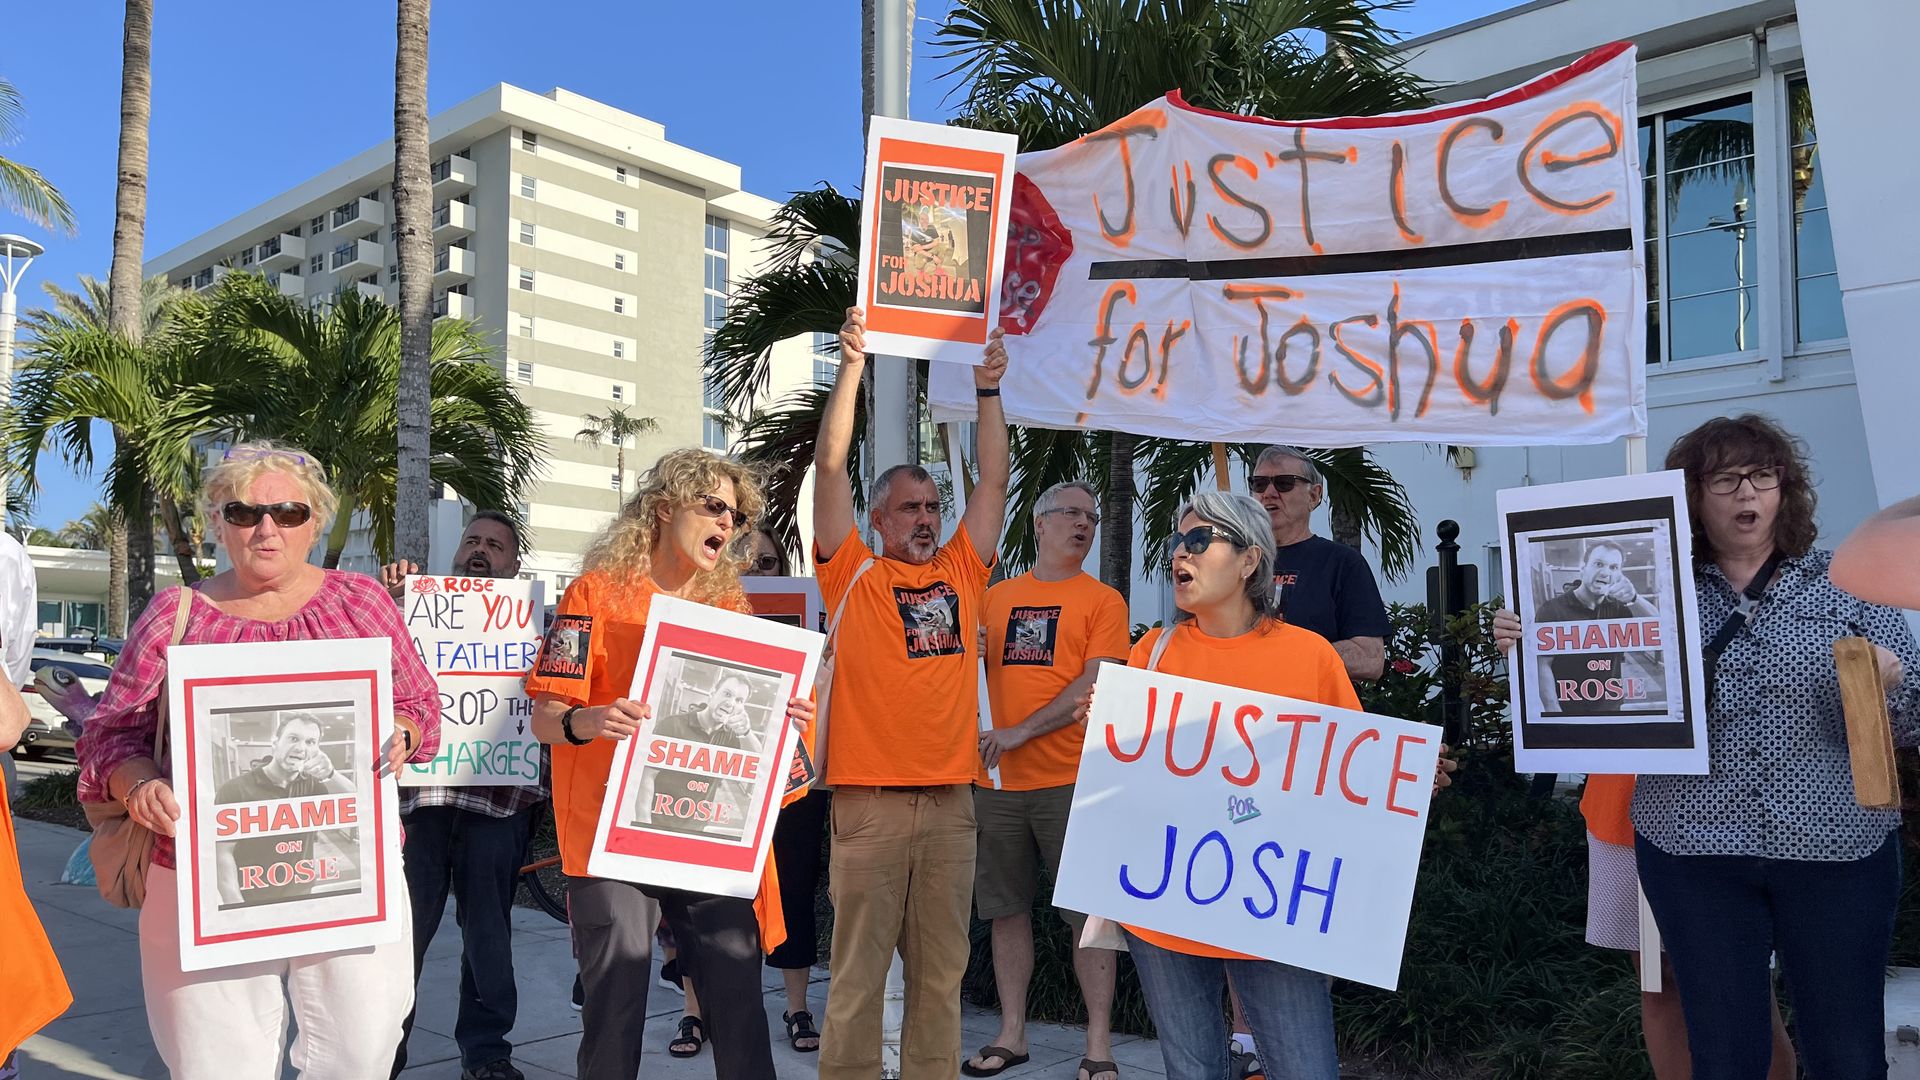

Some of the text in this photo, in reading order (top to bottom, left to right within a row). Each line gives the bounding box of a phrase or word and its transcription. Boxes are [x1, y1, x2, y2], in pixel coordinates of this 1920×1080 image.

[884, 178, 992, 212] JUSTICE
[881, 255, 907, 272] FOR
[880, 271, 981, 303] JOSHUA
[1088, 280, 1607, 422] for Joshua
[443, 577, 495, 593] ROSE
[897, 585, 956, 604] JUSTICE
[408, 593, 535, 632] ARE YOU
[1010, 609, 1060, 621] JUSTICE
[413, 636, 428, 665] A
[909, 633, 961, 653] JOSHUA
[1536, 621, 1662, 651] SHAME
[539, 659, 584, 675] JOSHUA
[1003, 649, 1052, 661] JOSHUA
[1587, 660, 1611, 671] ON
[1557, 678, 1647, 701] ROSE
[439, 689, 498, 726] ROP
[647, 739, 760, 780] SHAME
[1106, 687, 1427, 817] JUSTICE
[687, 780, 709, 793] ON
[216, 797, 358, 836] SHAME
[651, 793, 733, 825] ROSE
[275, 840, 303, 854] ON
[239, 857, 340, 891] ROSE
[1119, 825, 1343, 934] JOSH
